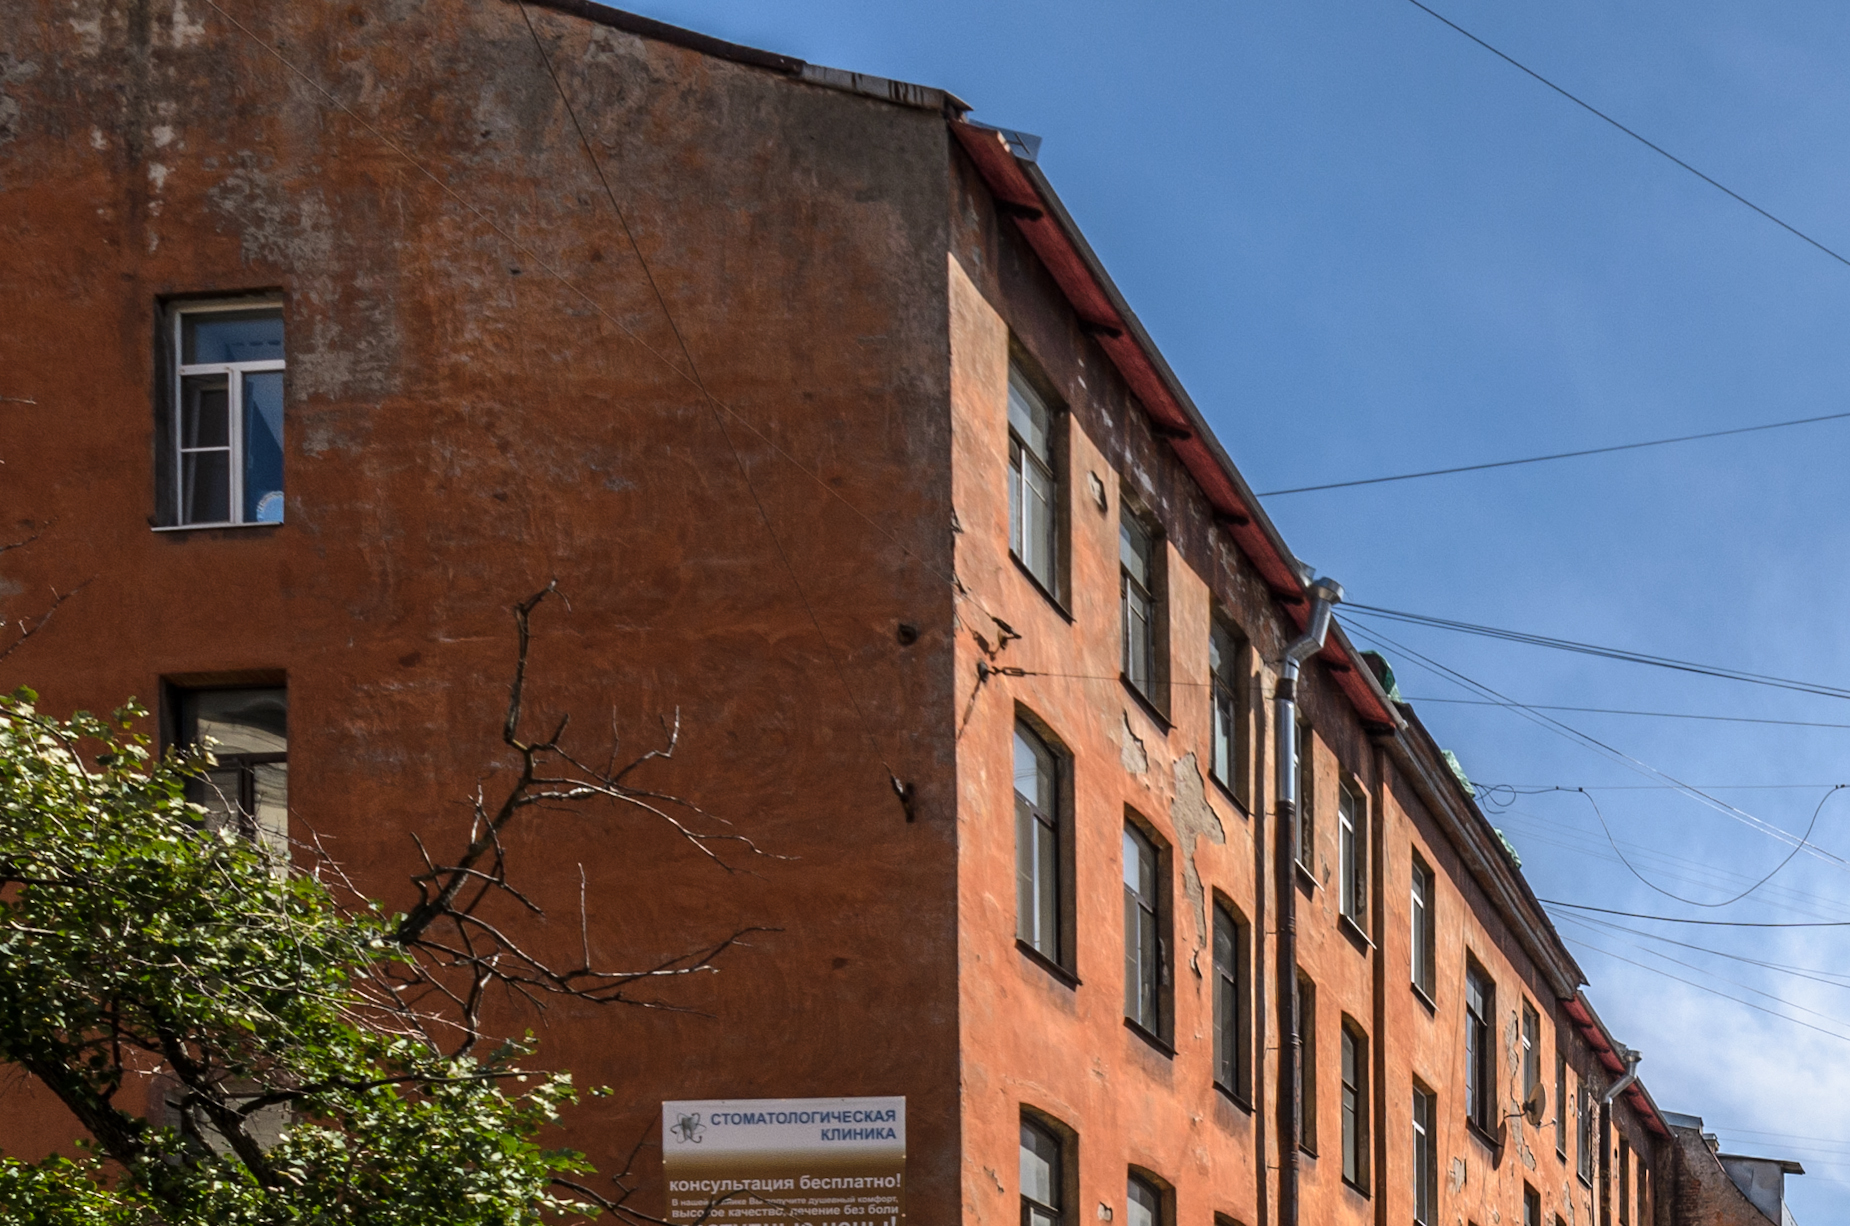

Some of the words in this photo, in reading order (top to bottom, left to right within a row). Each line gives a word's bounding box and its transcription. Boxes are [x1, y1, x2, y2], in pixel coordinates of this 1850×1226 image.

[710, 1110, 896, 1126] СТОМАТОЛОГИЧЕСКАЯ
[820, 1128, 896, 1141] КЛИНИКА
[669, 1178, 794, 1194] консультация
[800, 1173, 902, 1190] бесплатно!
[672, 1209, 725, 1218] высоое
[844, 1204, 865, 1215] без
[868, 1204, 899, 1214] боли
